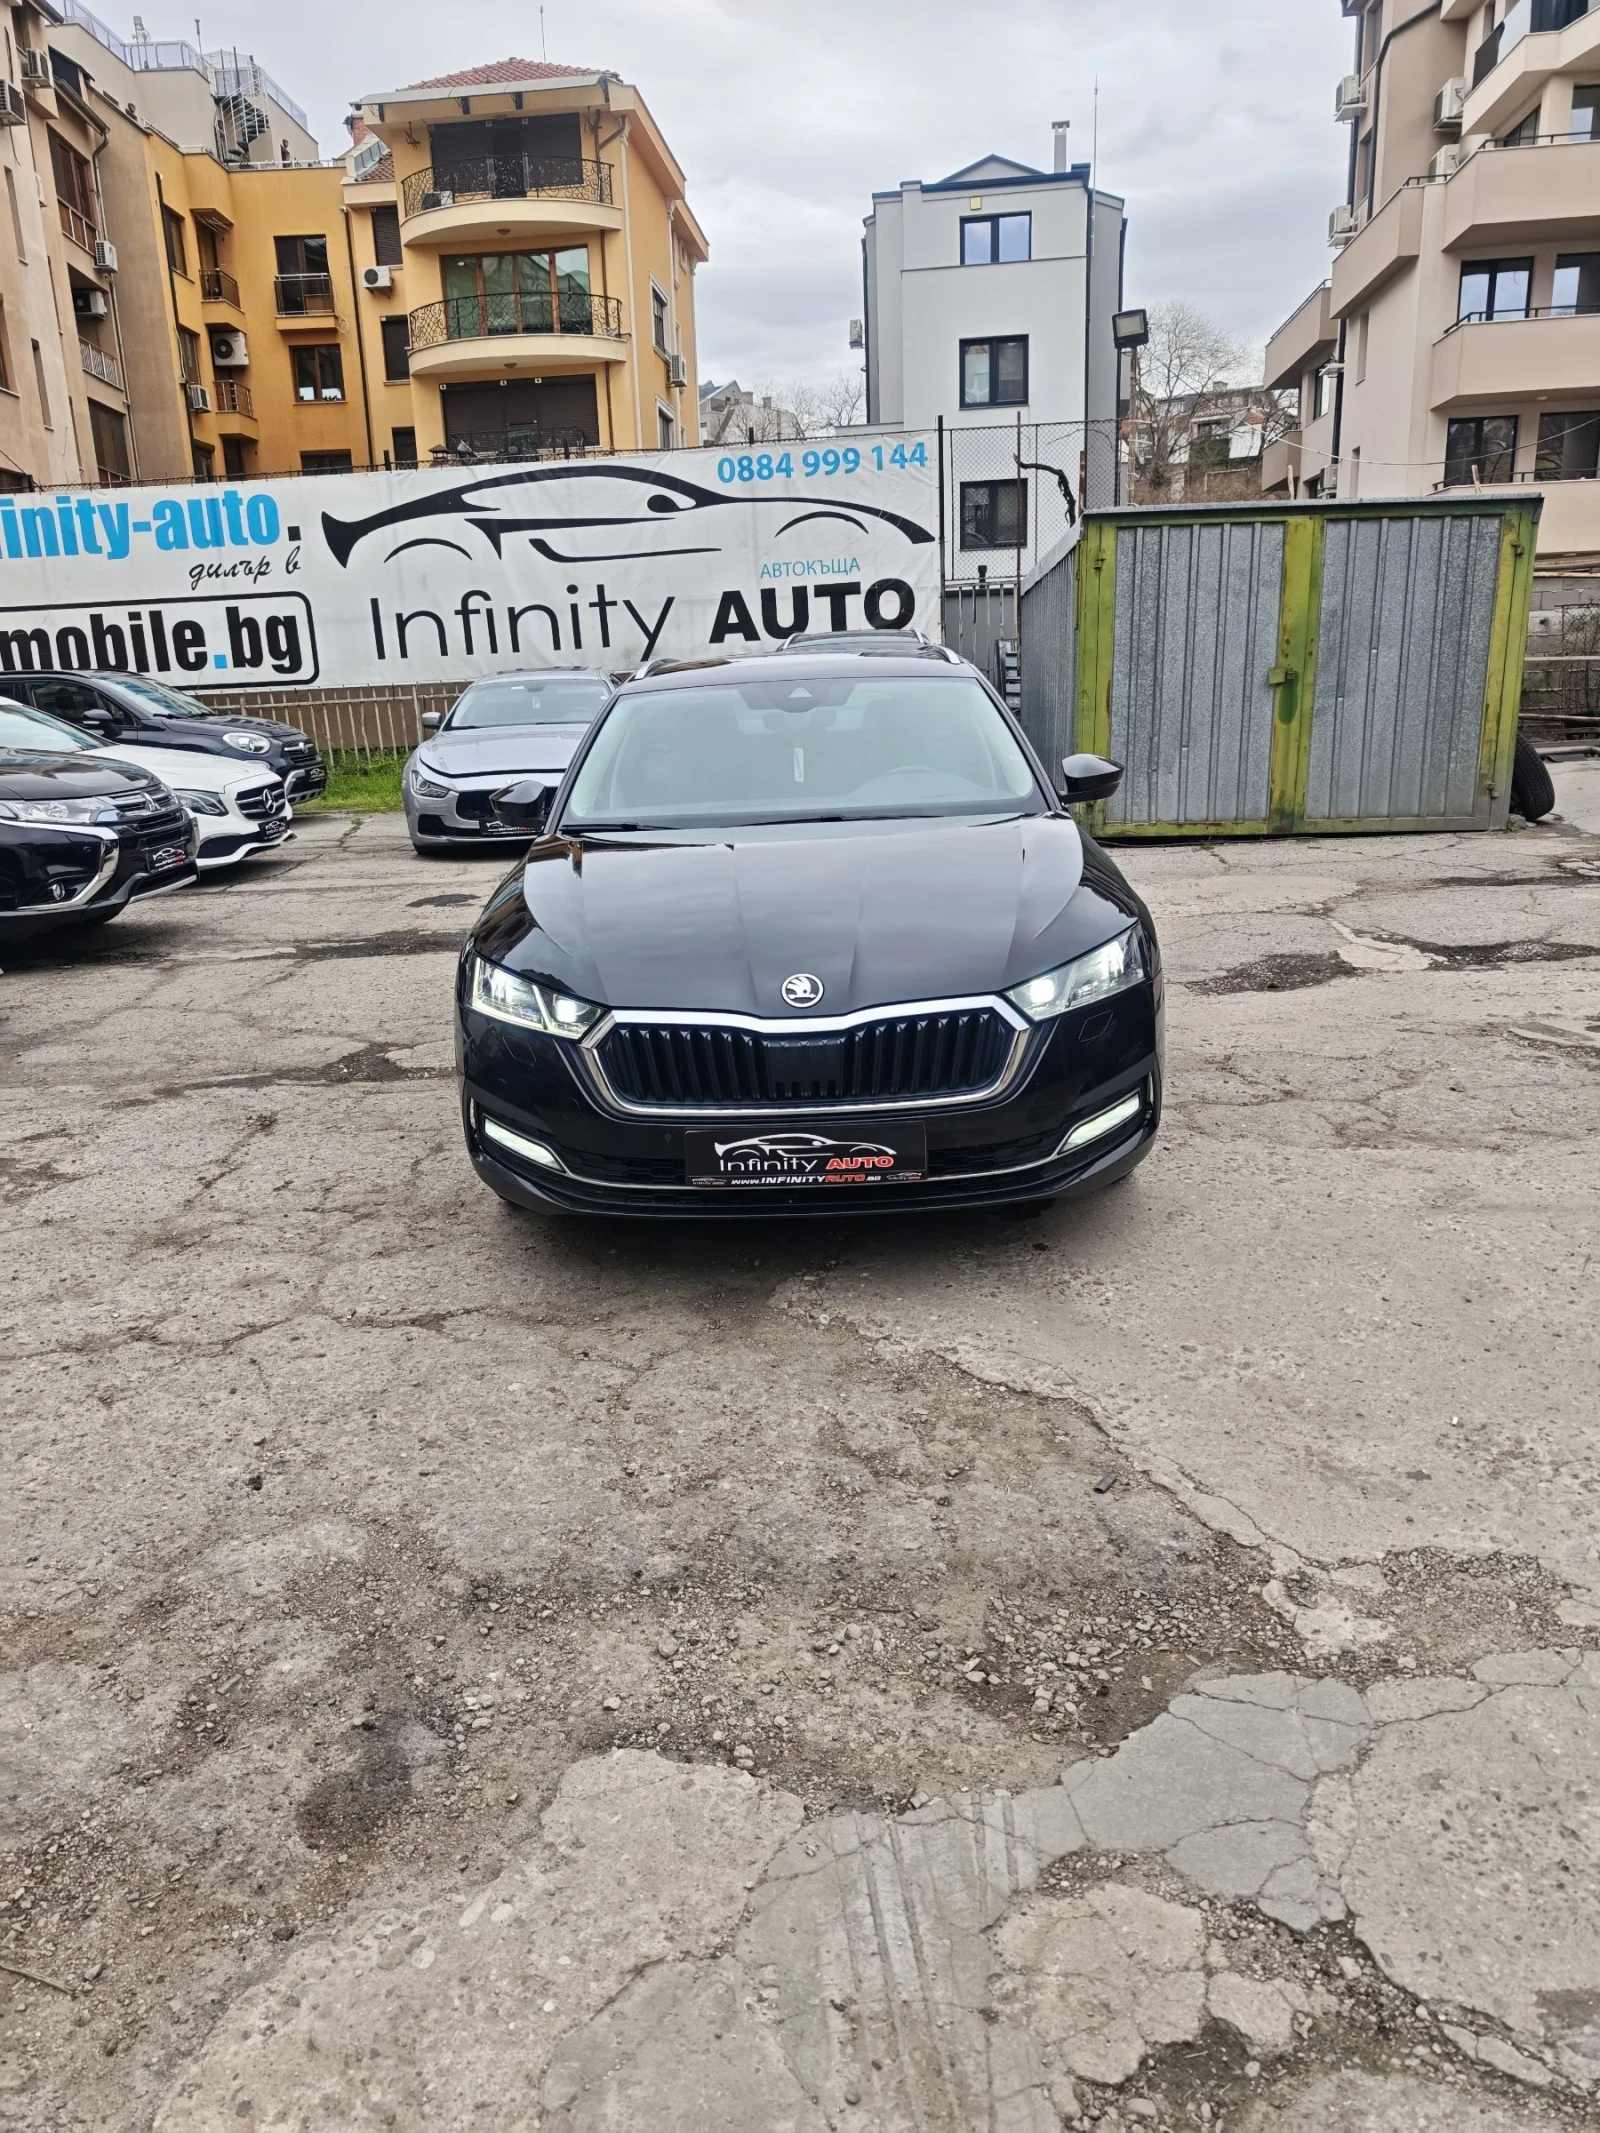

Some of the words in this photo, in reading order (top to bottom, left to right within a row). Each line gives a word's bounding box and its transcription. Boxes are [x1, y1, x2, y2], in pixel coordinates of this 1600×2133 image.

[717, 455, 794, 484] 0884
[802, 447, 861, 478] 999
[872, 441, 928, 471] 144
[0, 490, 301, 560] inity-auto.
[760, 557, 861, 579] АВТОКЪЩА
[0, 607, 303, 674] mobile.bg
[369, 584, 676, 662] Infinity
[709, 578, 916, 644] AUTO
[719, 1157, 817, 1172] Infinity
[826, 1155, 894, 1170] AUTO
